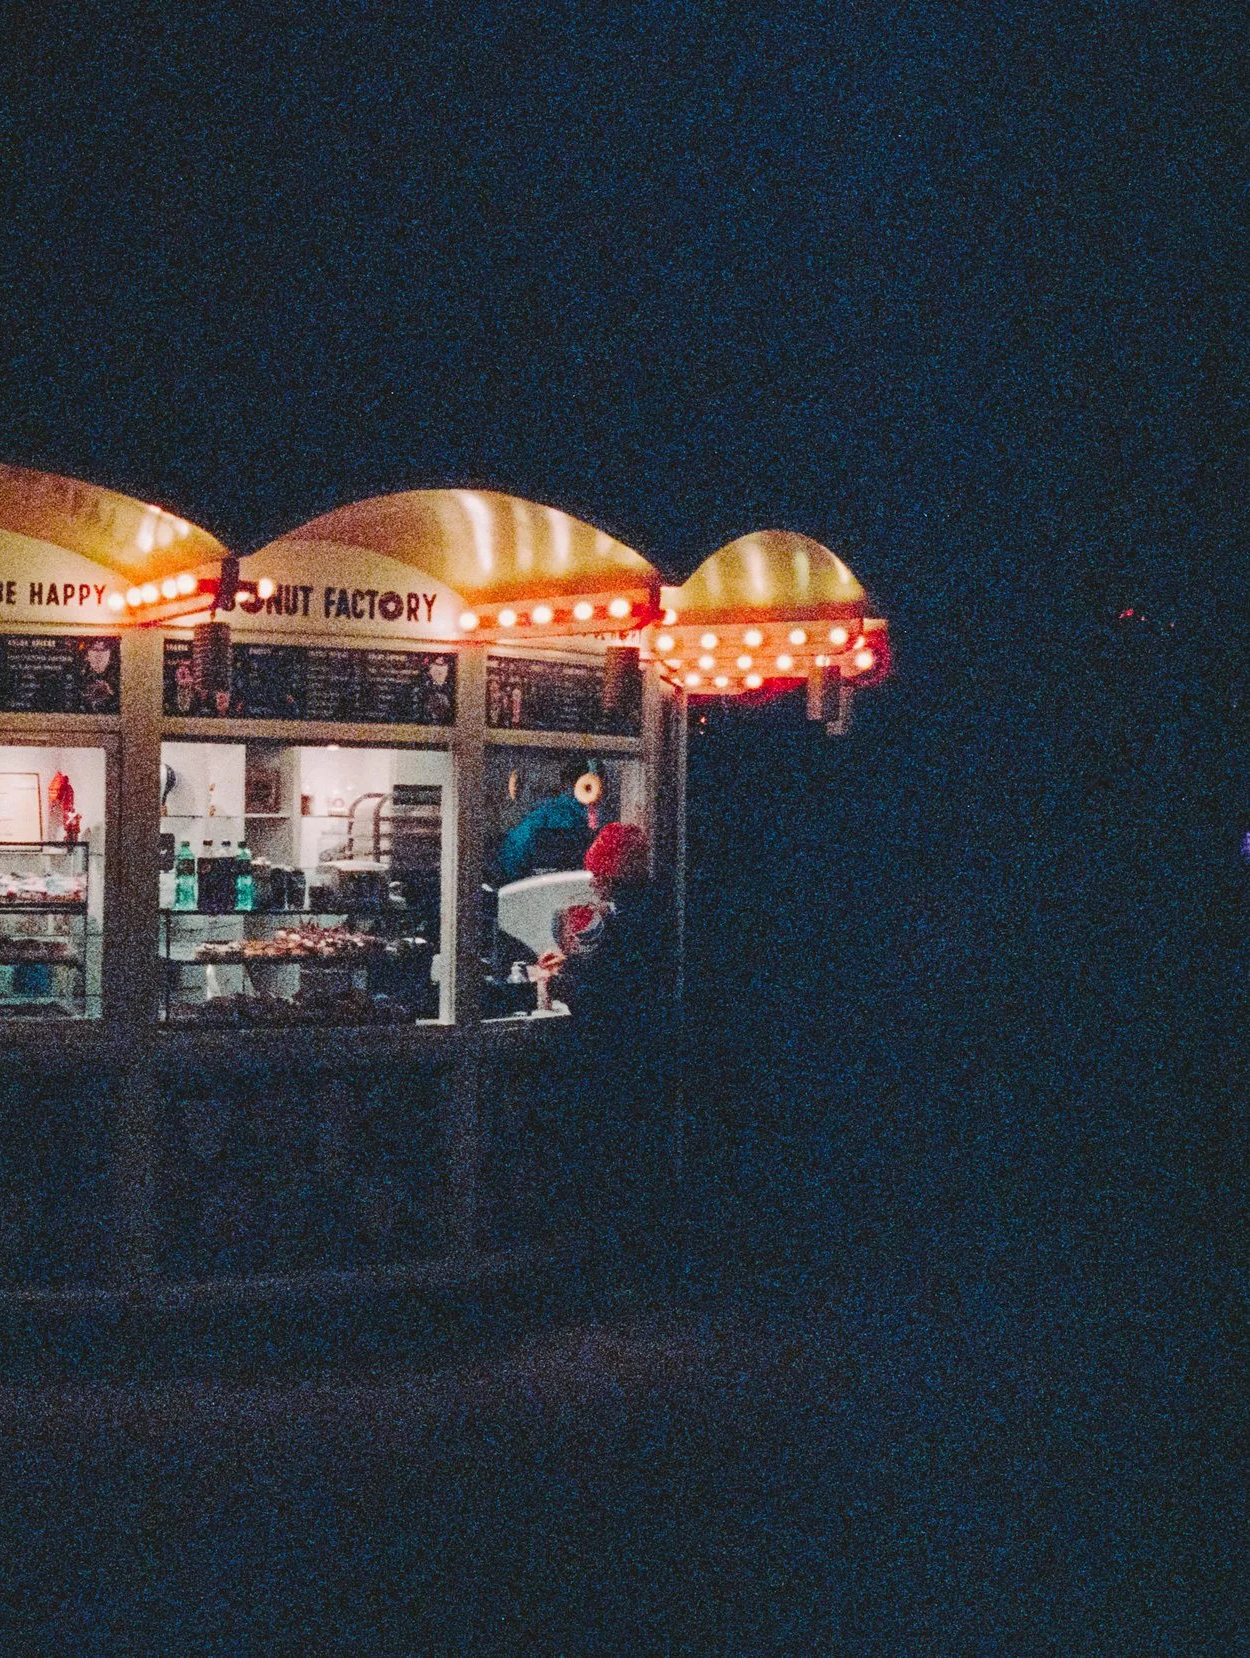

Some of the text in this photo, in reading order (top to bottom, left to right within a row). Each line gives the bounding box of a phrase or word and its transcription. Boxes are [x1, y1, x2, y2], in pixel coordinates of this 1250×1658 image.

[29, 582, 106, 606] HAPPY
[222, 583, 437, 622] ONUT FACTORY
